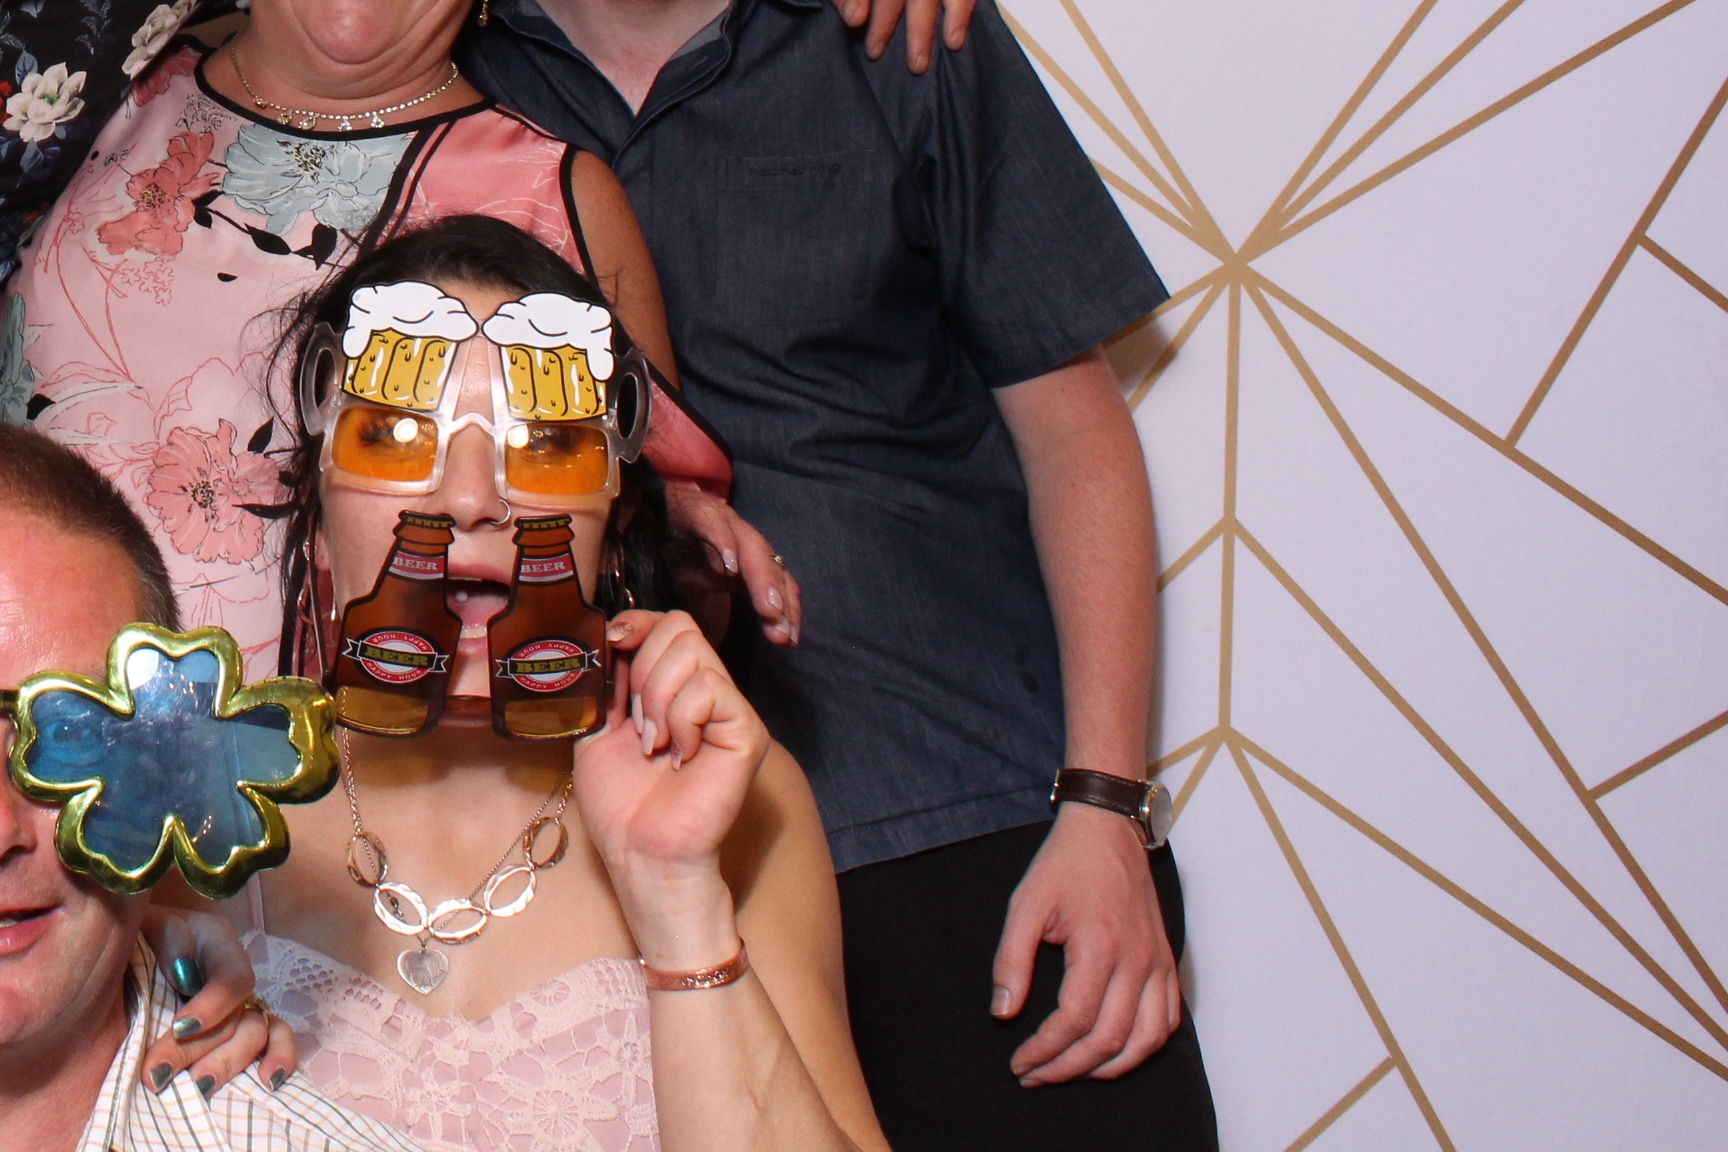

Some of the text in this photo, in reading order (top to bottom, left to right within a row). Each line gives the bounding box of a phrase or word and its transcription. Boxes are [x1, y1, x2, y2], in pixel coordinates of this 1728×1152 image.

[393, 557, 437, 570] BEER
[520, 561, 565, 573] BEER
[364, 646, 429, 666] BEER
[515, 658, 581, 673] BEER
